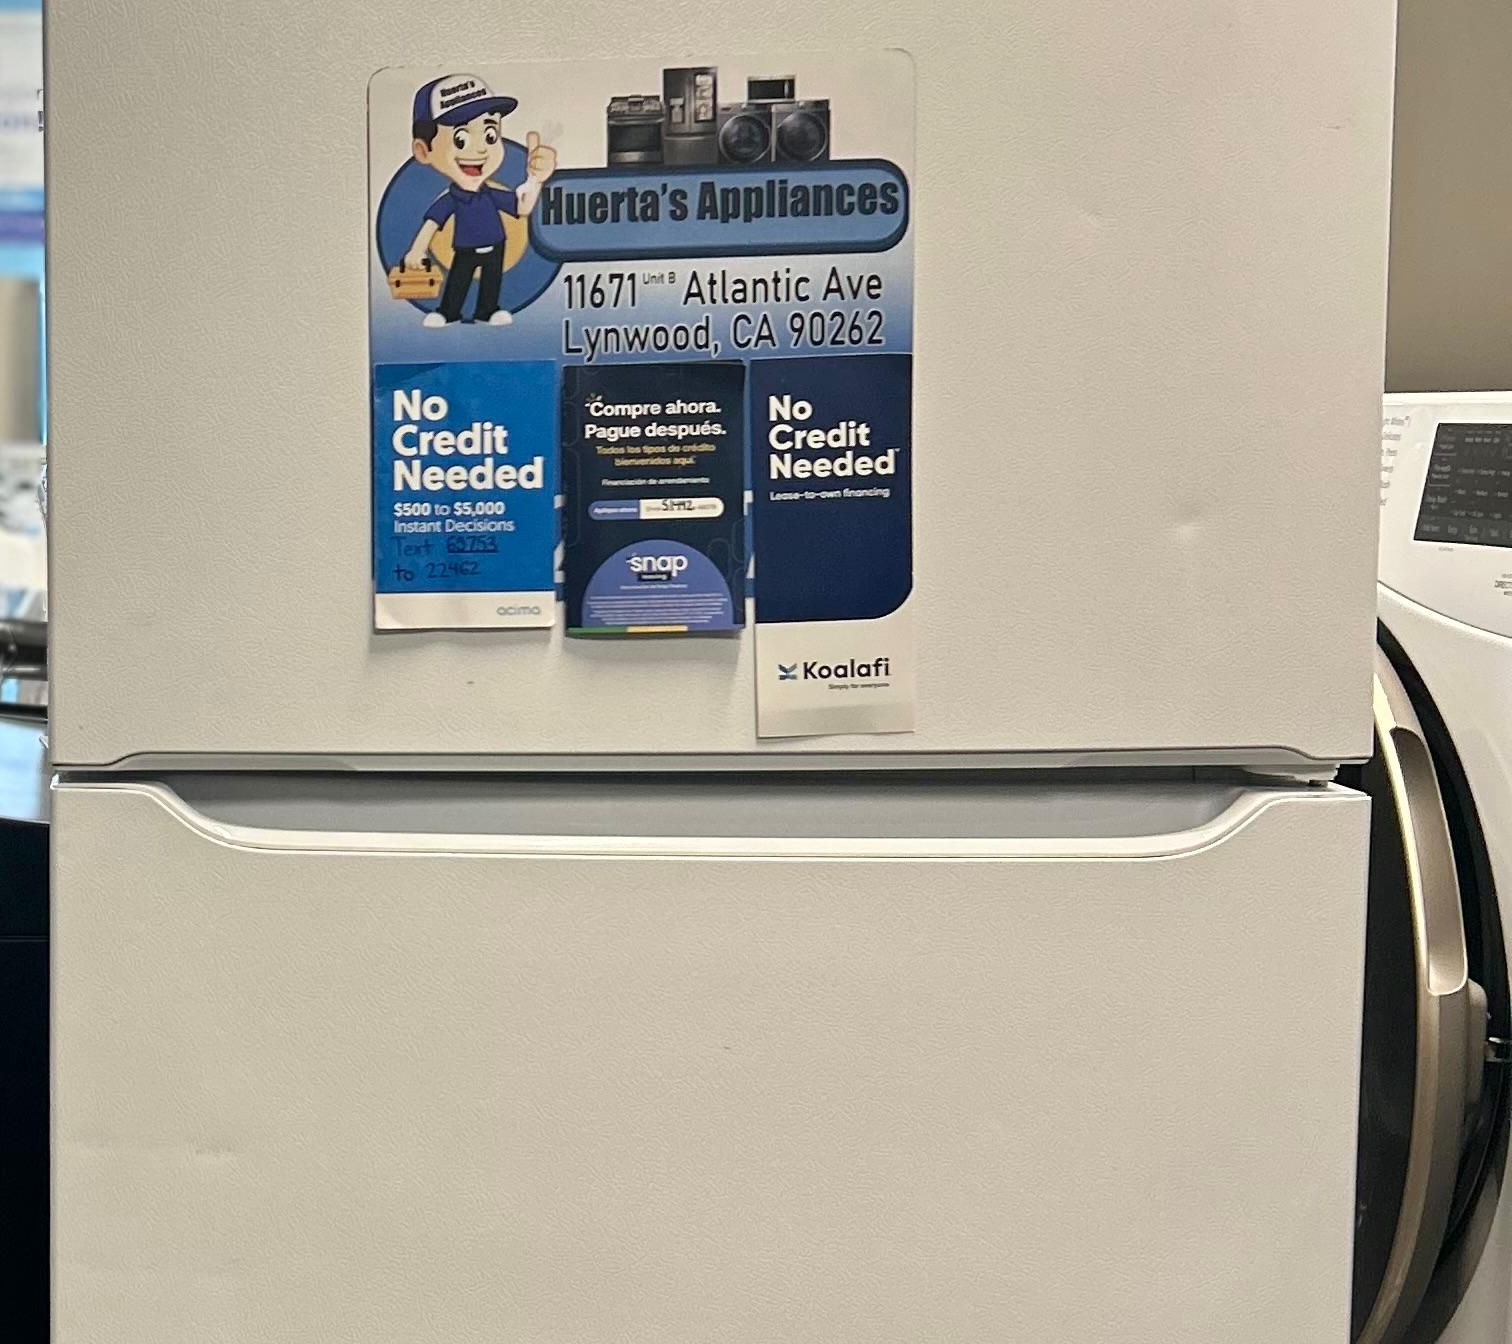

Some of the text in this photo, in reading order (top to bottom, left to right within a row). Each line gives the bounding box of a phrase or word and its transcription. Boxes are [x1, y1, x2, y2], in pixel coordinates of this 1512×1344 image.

[541, 177, 900, 226] Huerta's Appliances
[564, 266, 884, 310] 11671 Unit B Atlantic Ave
[564, 309, 884, 363] Lynwood, CA 90262
[393, 389, 449, 422] No
[589, 399, 722, 419] Compre ahora.
[769, 394, 813, 422] No
[392, 421, 508, 457] Credit
[584, 420, 727, 442] Pague después.
[768, 420, 871, 451] Credit
[393, 456, 545, 491] Needed
[769, 448, 895, 480] Needed
[769, 486, 891, 501] Lease-to-own financing
[393, 501, 506, 517] $500 to $5,000
[393, 518, 516, 534] Instant Decisions
[390, 536, 434, 556] Text
[391, 563, 415, 582] to
[630, 554, 688, 577] snap
[496, 605, 543, 616] acima
[802, 657, 890, 680] Koalafi
